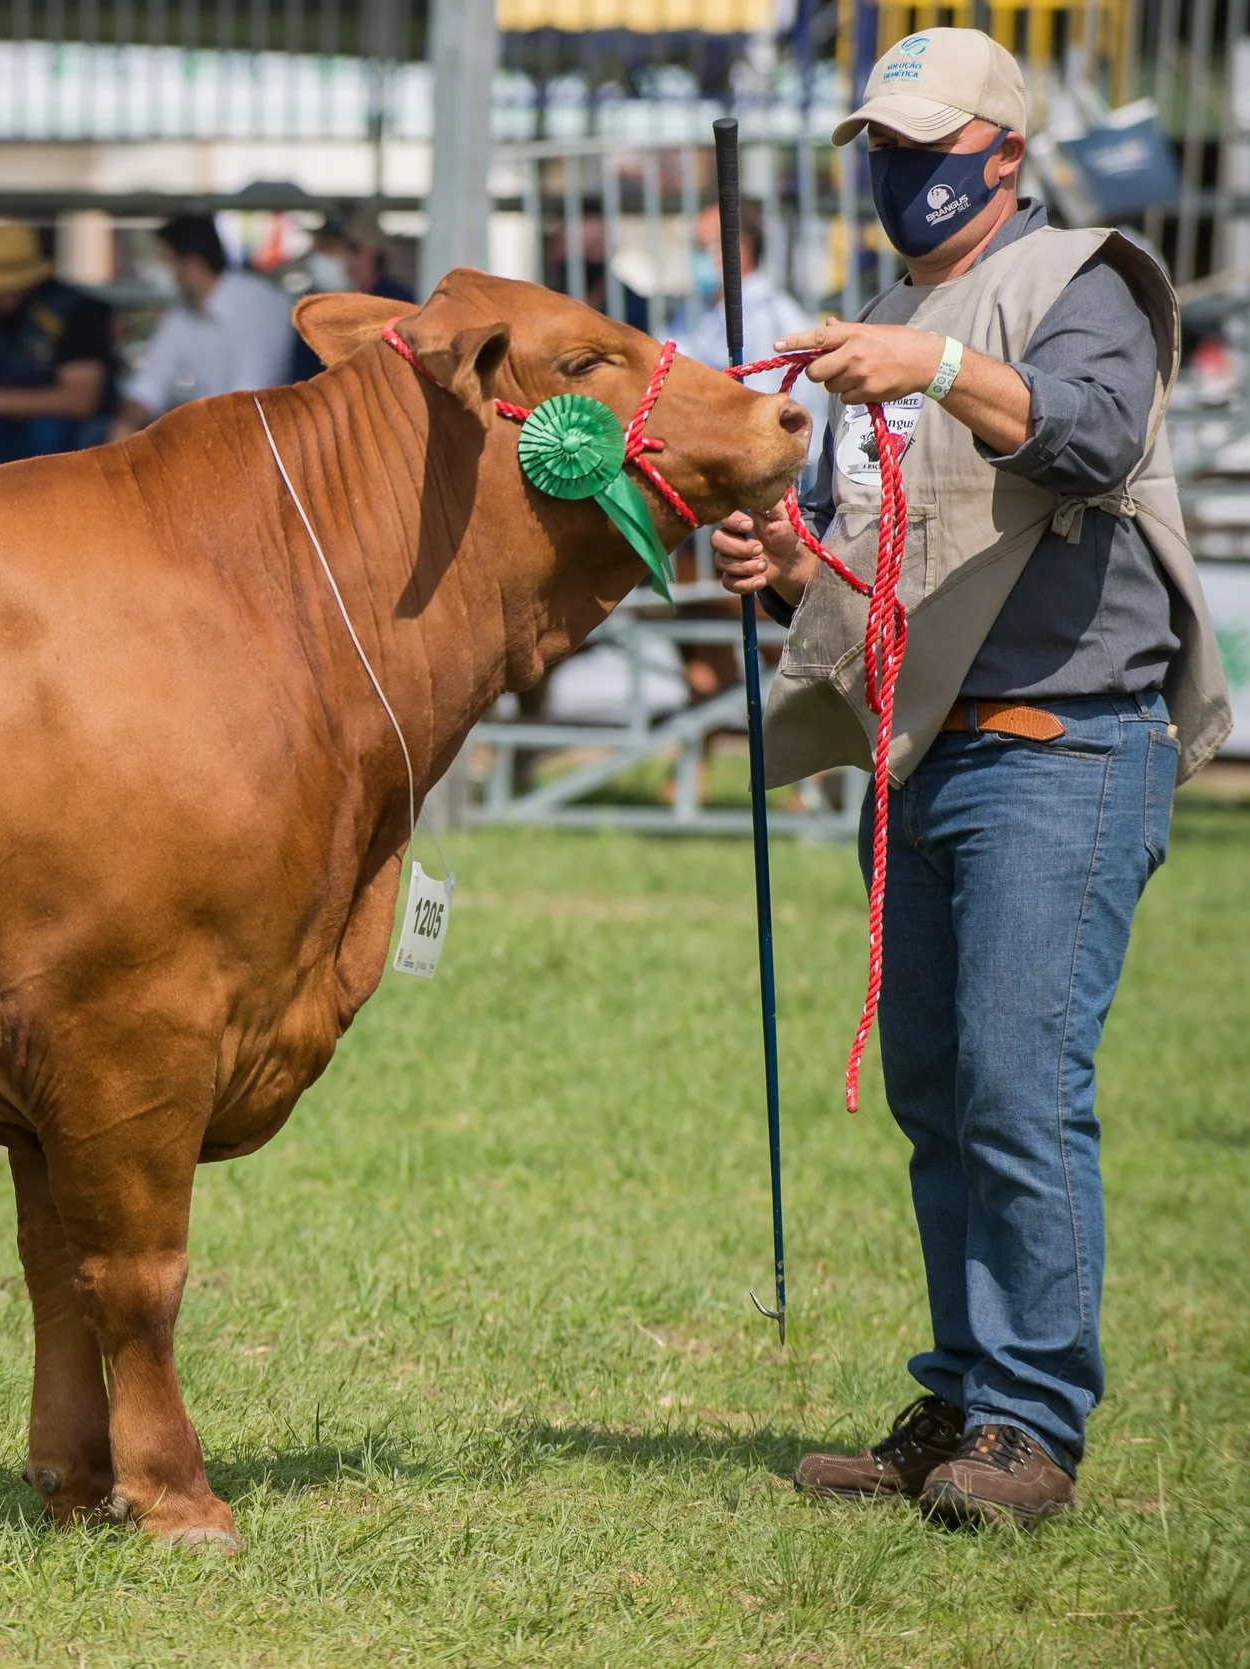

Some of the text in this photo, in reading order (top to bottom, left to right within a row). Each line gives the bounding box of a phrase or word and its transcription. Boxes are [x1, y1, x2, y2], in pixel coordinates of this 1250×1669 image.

[926, 194, 969, 222] BRANGUS
[957, 202, 971, 213] SUL
[413, 897, 445, 939] 1205
